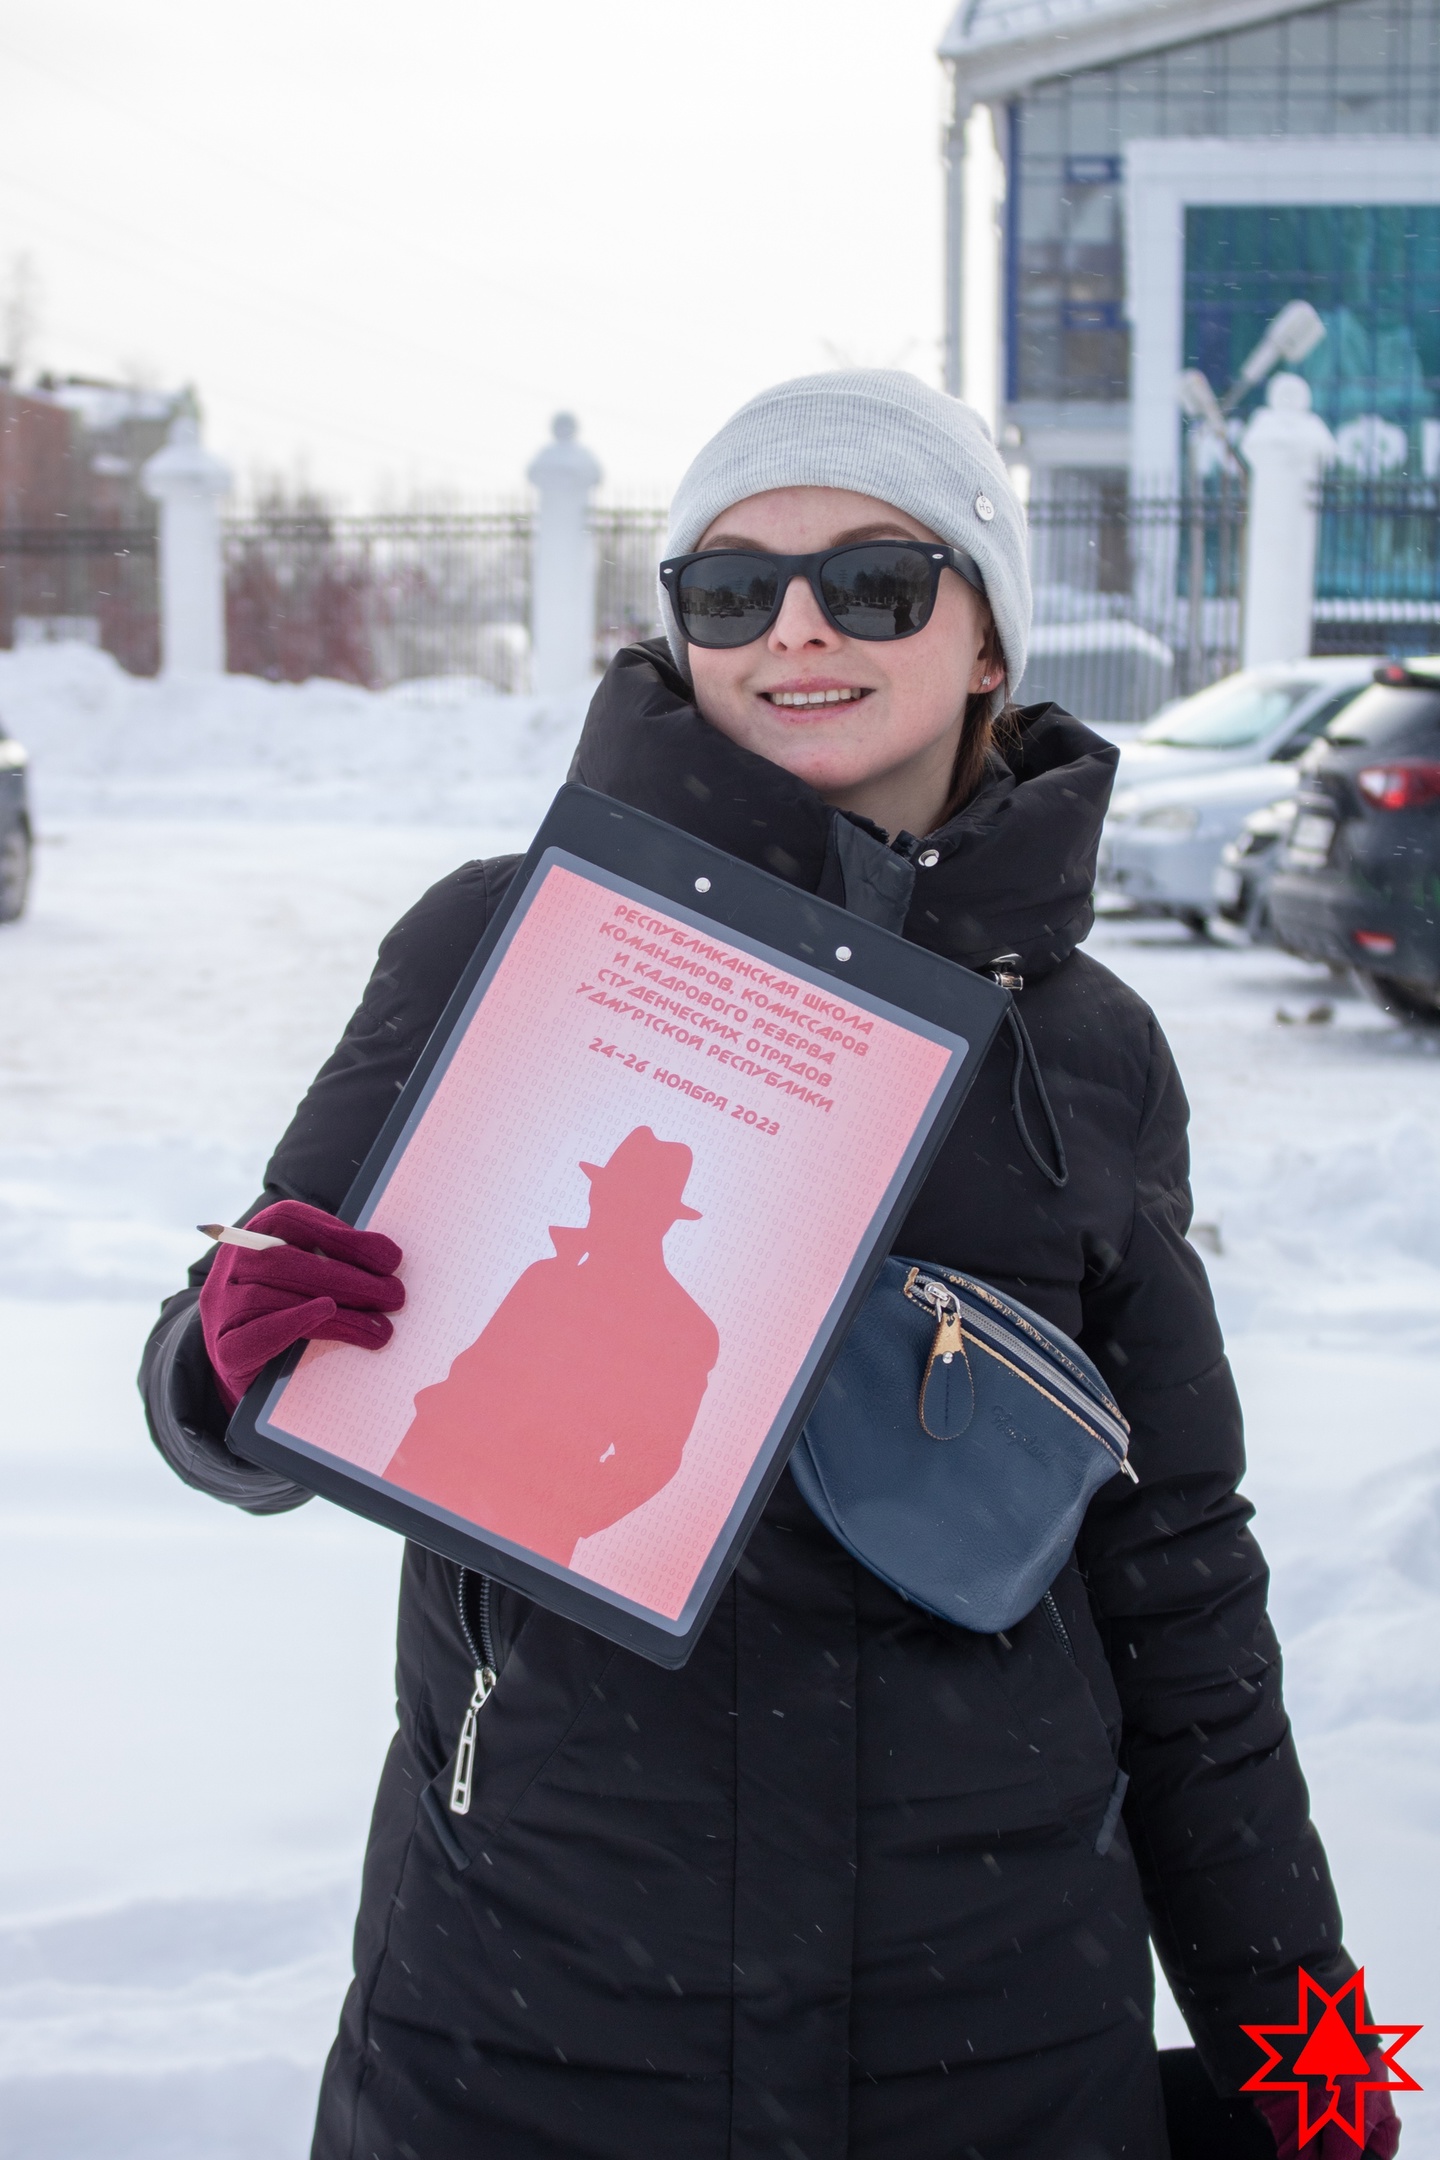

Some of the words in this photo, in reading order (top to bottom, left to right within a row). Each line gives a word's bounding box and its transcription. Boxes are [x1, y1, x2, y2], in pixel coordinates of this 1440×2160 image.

[599, 970, 742, 1043] СТУДЕНЧЕСКИХ
[747, 1039, 831, 1087] ОТРЯДОВ
[600, 923, 733, 994] КОМАНДИРОВ,
[741, 989, 868, 1055] КОМИССАРОВ
[614, 953, 629, 967] И
[634, 962, 747, 1022] КАДРОВОГО
[753, 1018, 835, 1064] РЕЗЕРВА
[615, 906, 799, 999] РЕСПУБЛИКАНСКАЯ
[803, 994, 873, 1034] ШКОЛА
[577, 983, 704, 1050] УДМУРТСКОЙ
[707, 1045, 833, 1112] РЕСПУБЛИКИ
[589, 1038, 650, 1072] 24-26
[653, 1068, 728, 1111] НОЯБРЯ
[731, 1105, 779, 1135] 2023
